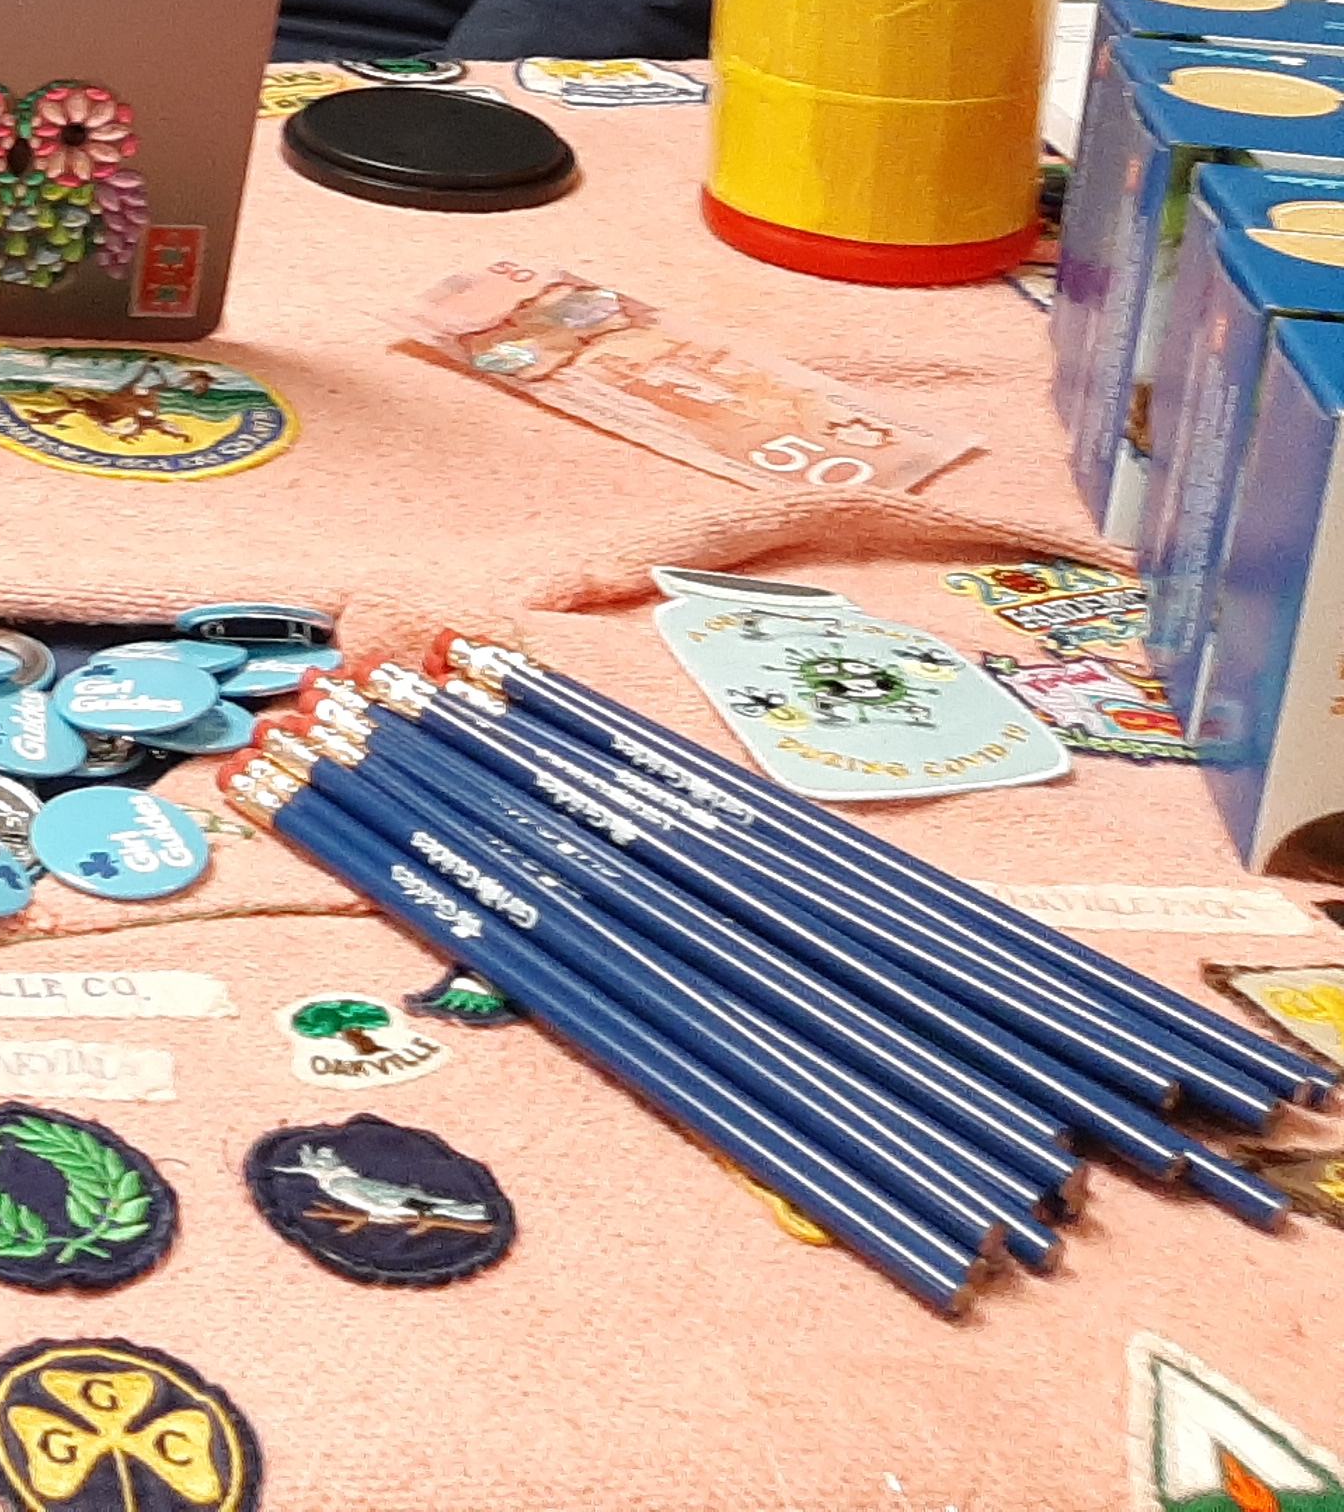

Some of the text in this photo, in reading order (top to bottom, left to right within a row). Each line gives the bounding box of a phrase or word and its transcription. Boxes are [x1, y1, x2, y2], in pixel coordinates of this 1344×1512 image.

[487, 260, 538, 284] 50
[749, 434, 877, 489] 50
[68, 695, 184, 713] Guides
[71, 678, 136, 697] Girl
[922, 743, 1009, 777] COVID
[129, 794, 195, 868] Guides
[107, 830, 161, 874] Girl
[81, 976, 152, 1002] CO.
[309, 1036, 441, 1077] OAKVILLE
[80, 1378, 120, 1411] G
[36, 1426, 196, 1467] G C
